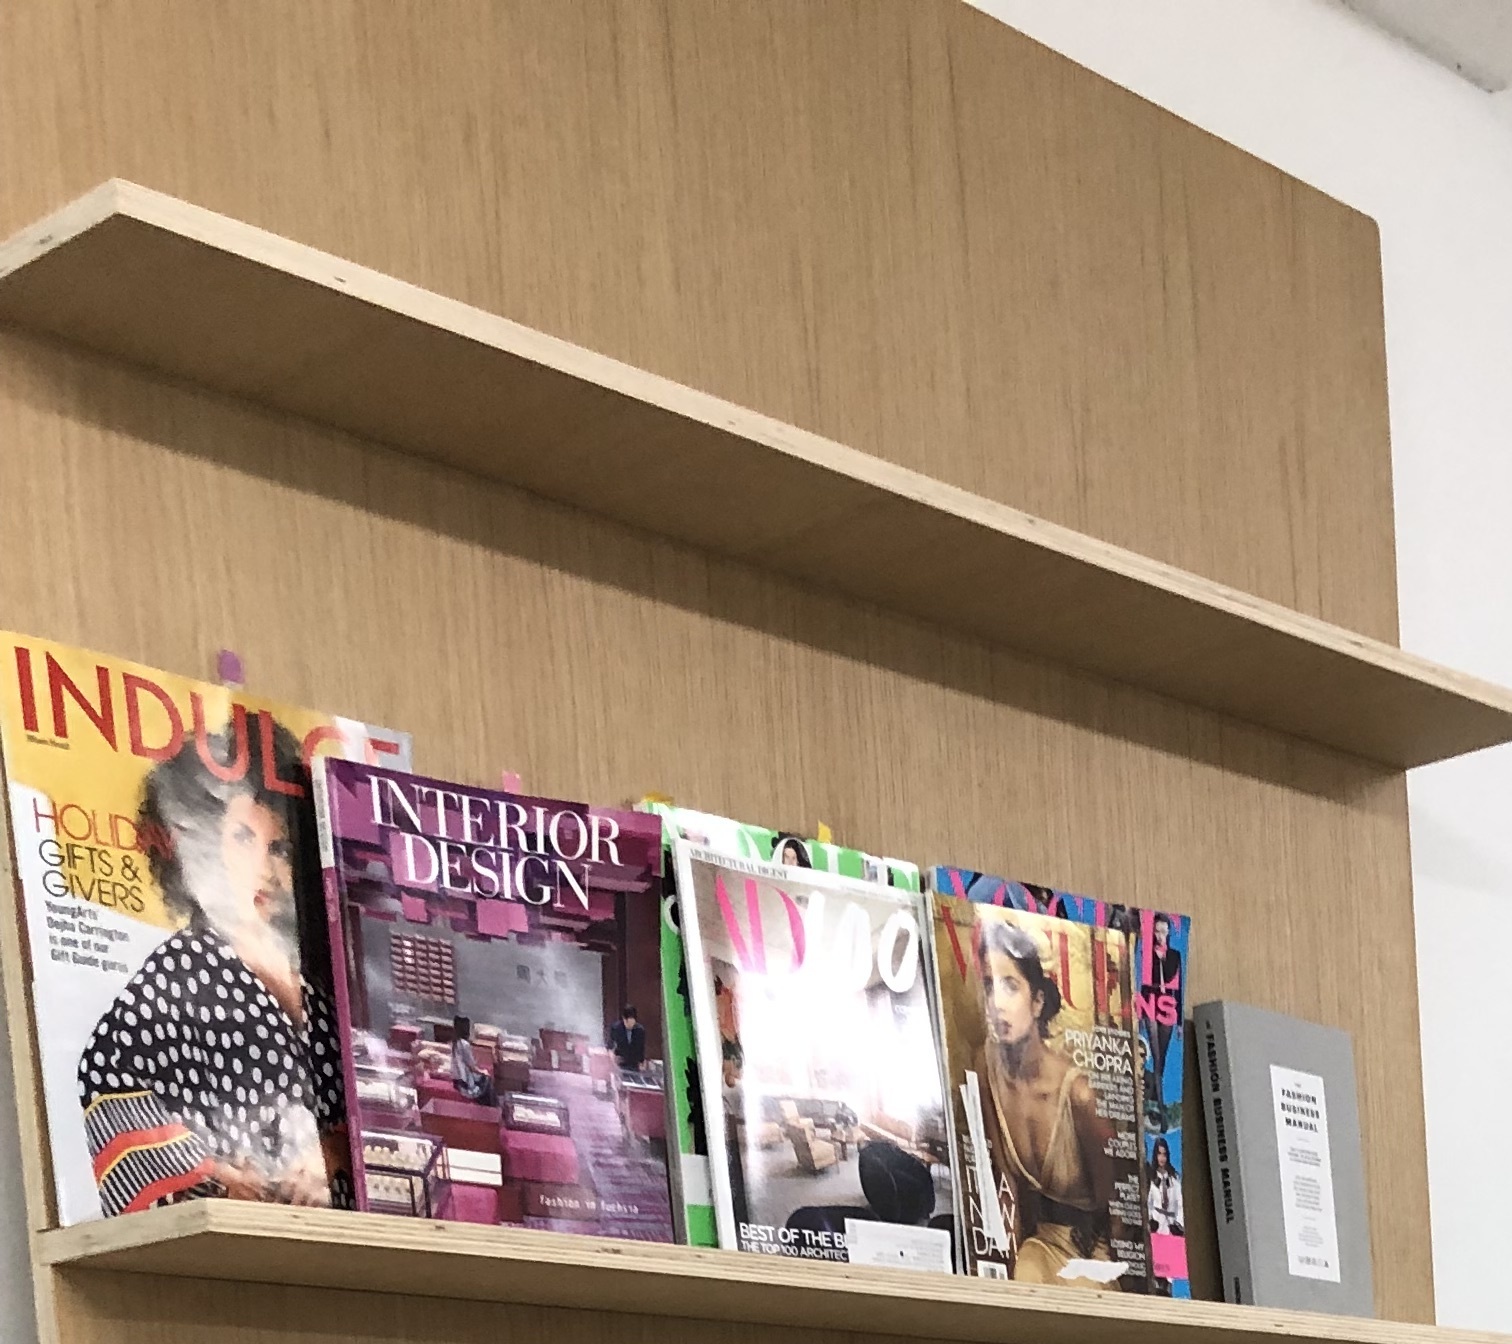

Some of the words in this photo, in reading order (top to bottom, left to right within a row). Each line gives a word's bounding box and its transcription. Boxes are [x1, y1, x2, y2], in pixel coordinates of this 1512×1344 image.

[368, 775, 624, 867] INTERIOR
[39, 838, 114, 877] GIFTS
[120, 855, 143, 884] &
[399, 832, 593, 912] DESIGN
[42, 869, 145, 913] GIVERS
[1065, 1028, 1133, 1058] PRIYANKA
[1073, 1050, 1133, 1076] CHOPRA
[1205, 1033, 1220, 1093] FASHION
[1280, 1102, 1320, 1120] BUSINESS
[1281, 1087, 1317, 1106] FASHION
[1211, 1097, 1229, 1163] BUSINESS
[1285, 1117, 1318, 1133] MANUAL
[1219, 1165, 1235, 1225] MANUAL
[739, 1222, 775, 1243] BEST
[778, 1227, 800, 1244] OF
[802, 1229, 833, 1248] THE
[760, 1241, 780, 1256] TOP
[781, 1244, 798, 1257] 100
